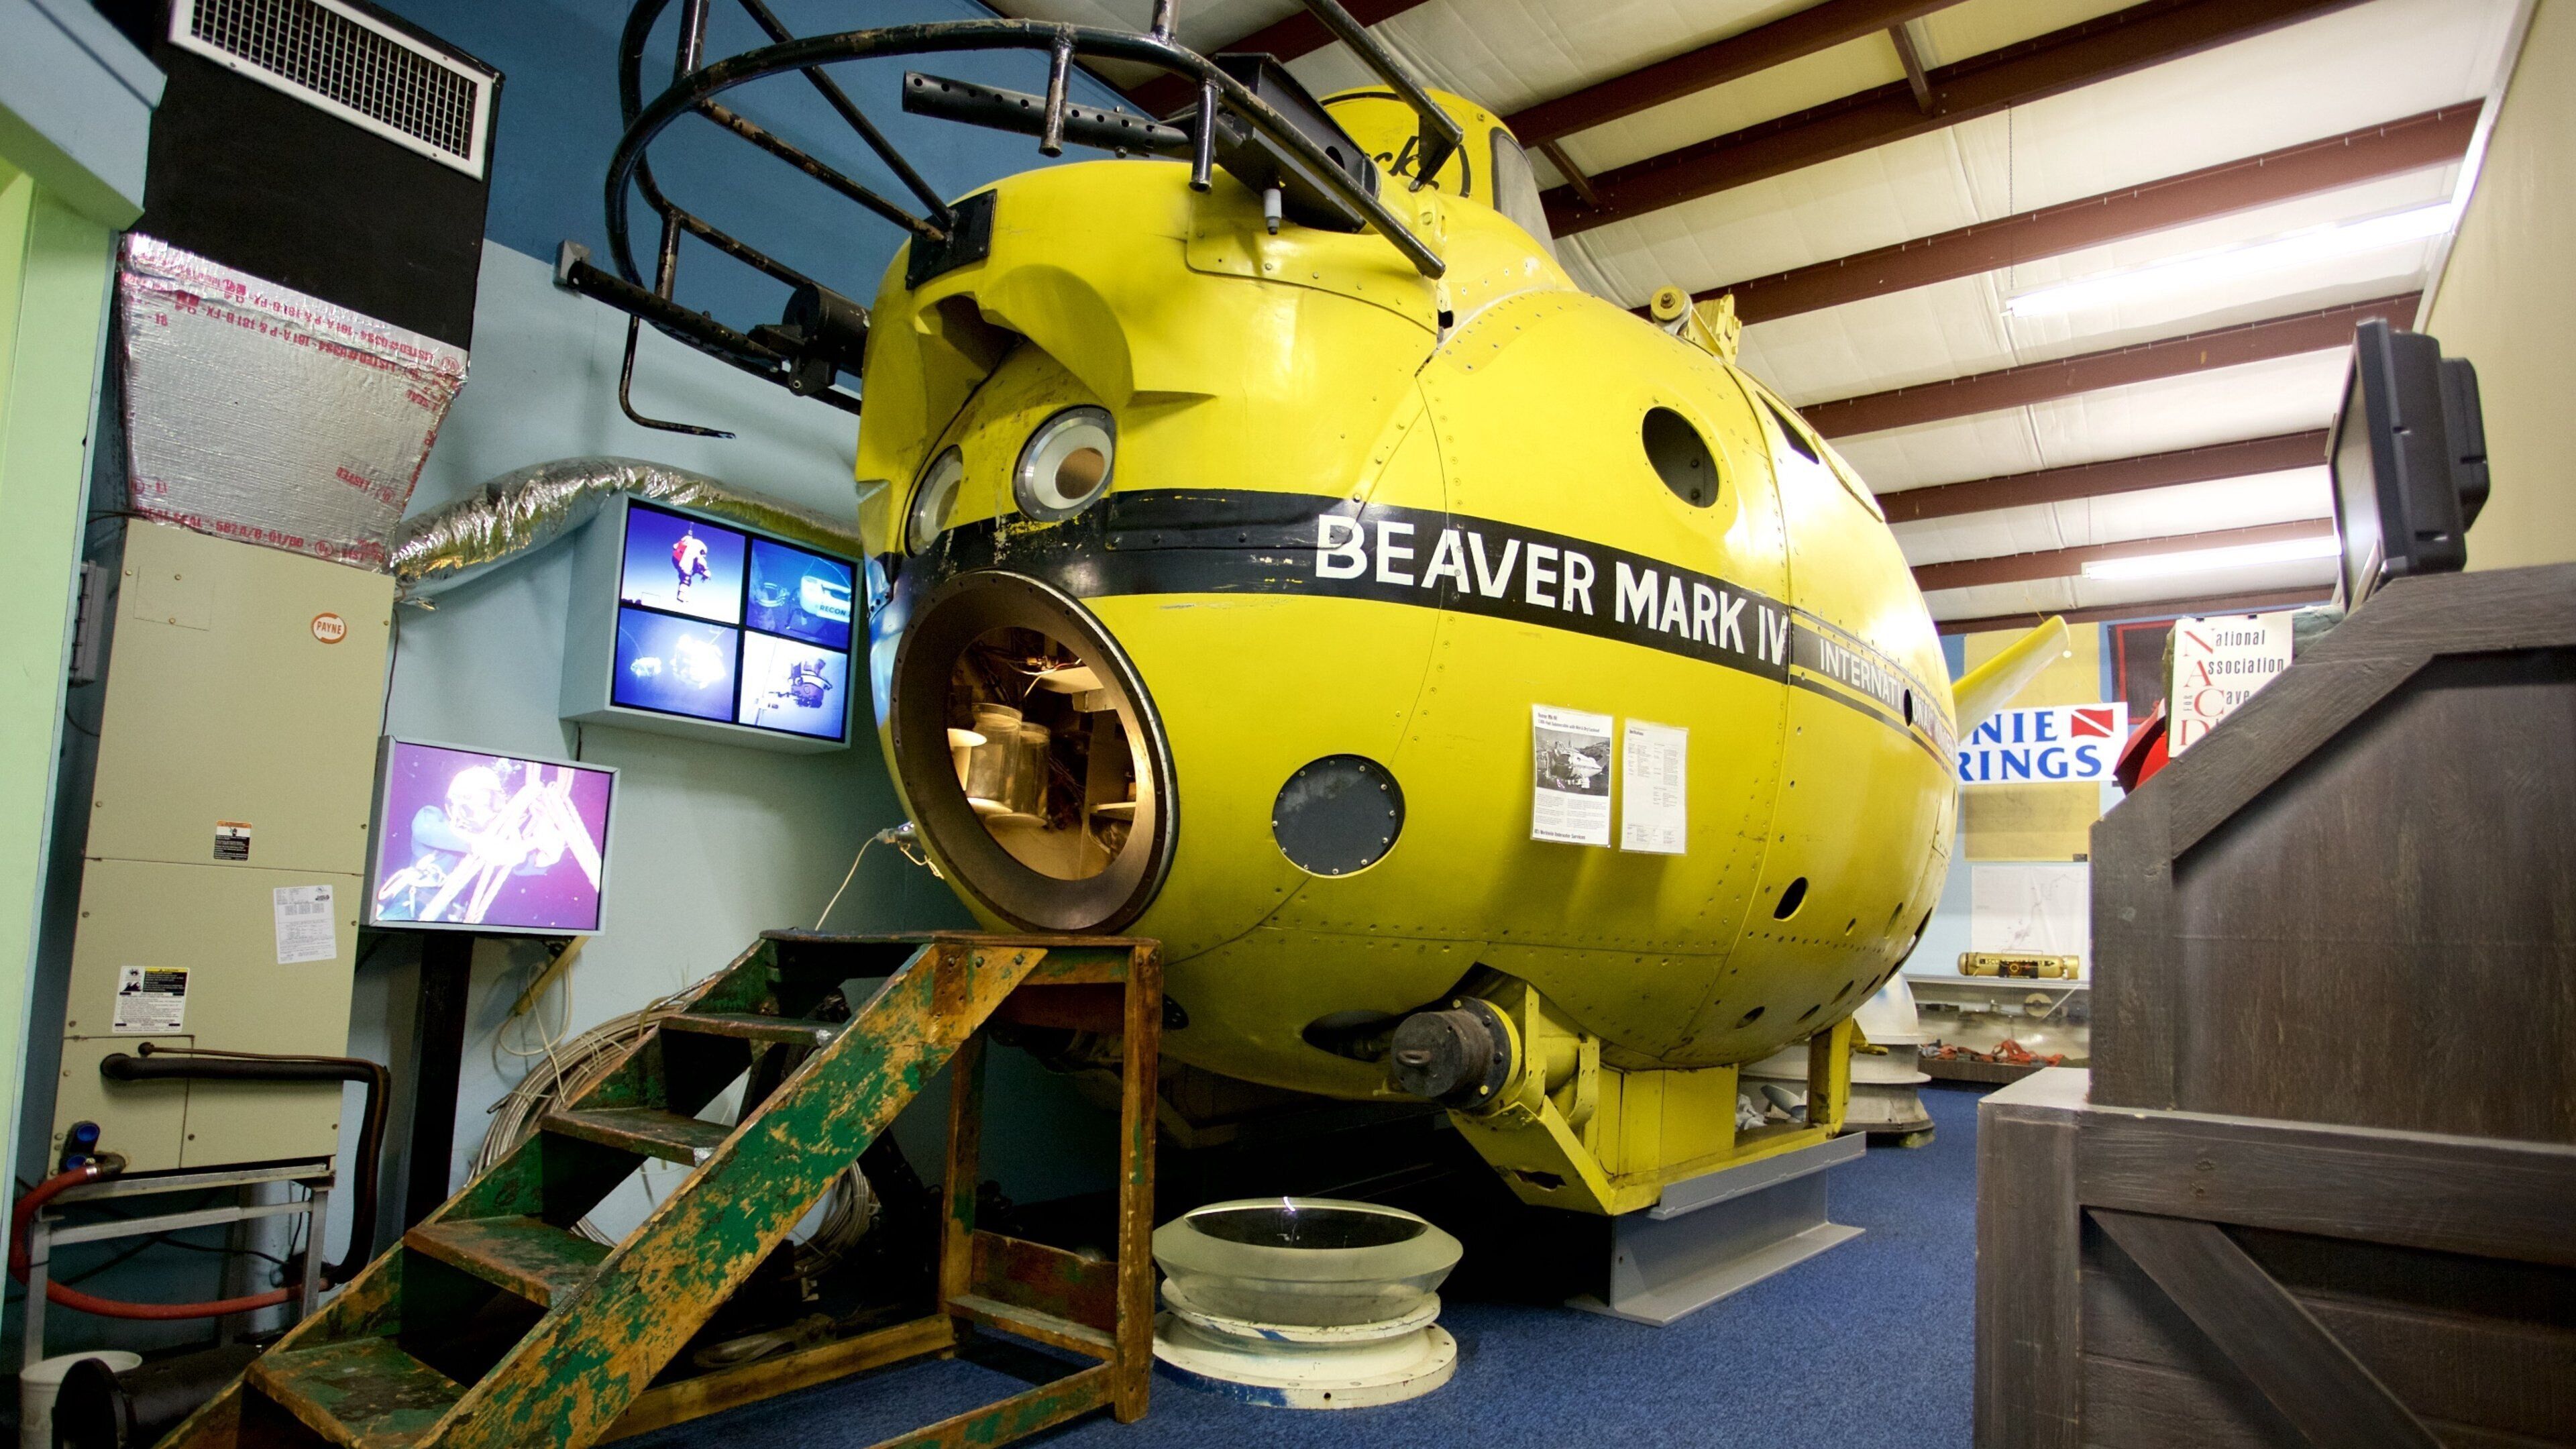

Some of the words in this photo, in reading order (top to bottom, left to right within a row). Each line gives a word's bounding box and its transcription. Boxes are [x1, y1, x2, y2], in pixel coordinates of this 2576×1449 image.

[360, 354, 396, 372] LISTED
[1316, 513, 1595, 616] BEAVER
[1615, 561, 1747, 655] MARK
[1758, 605, 1788, 666] IV
[819, 605, 847, 616] RECON
[317, 621, 342, 635] PAYNE
[2184, 628, 2265, 657] National
[2184, 657, 2284, 688] Association
[2194, 688, 2251, 718] Cave
